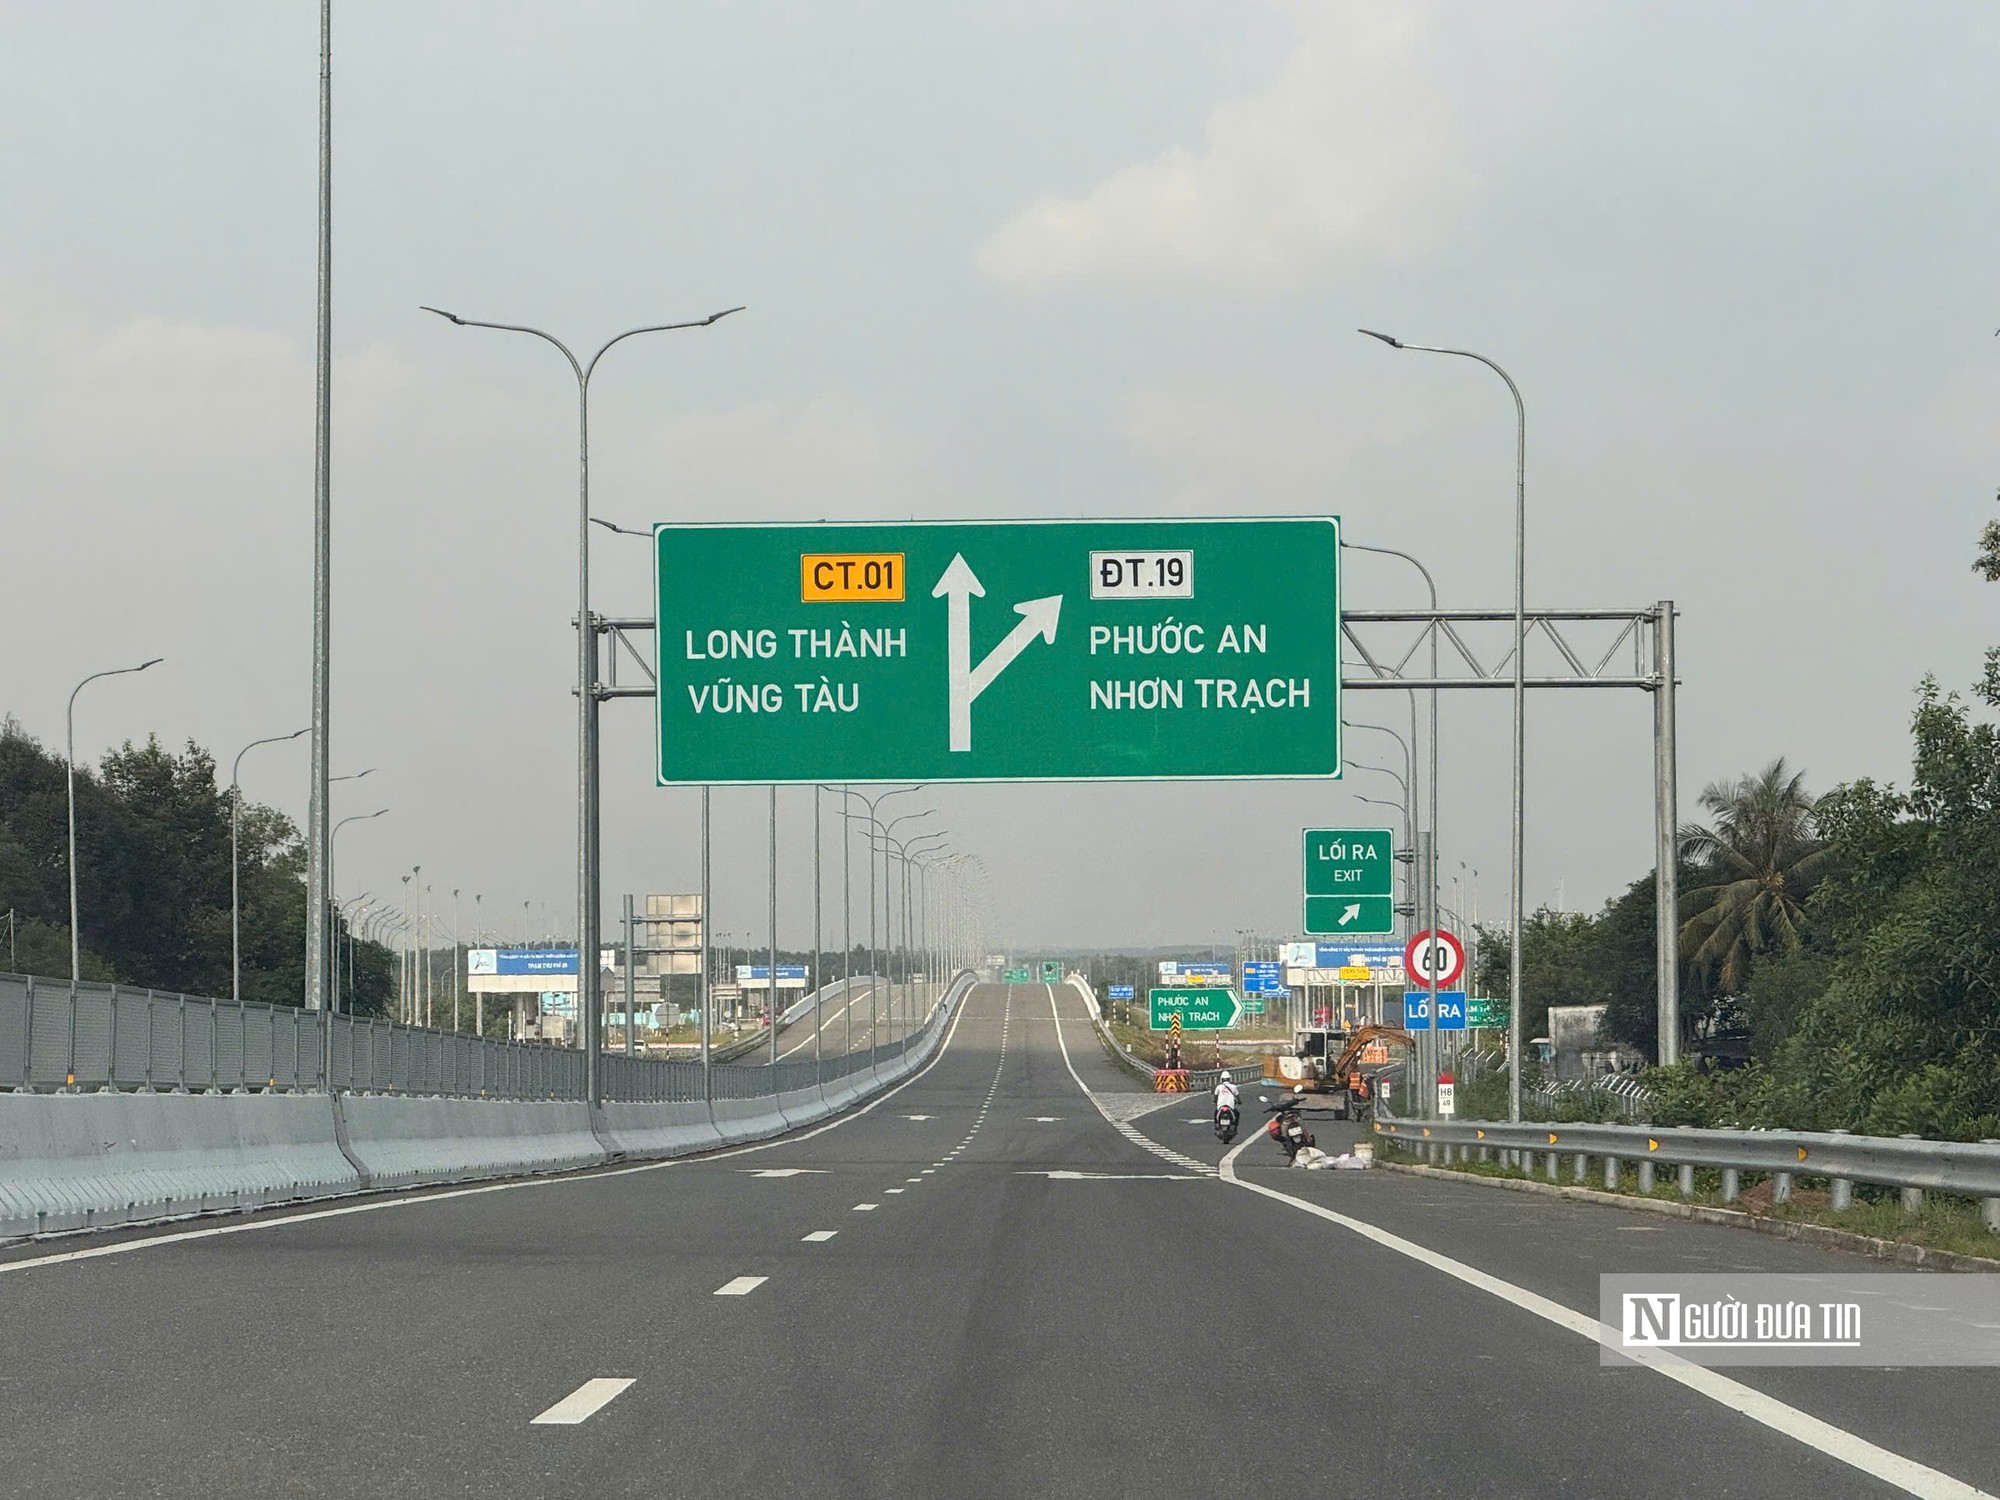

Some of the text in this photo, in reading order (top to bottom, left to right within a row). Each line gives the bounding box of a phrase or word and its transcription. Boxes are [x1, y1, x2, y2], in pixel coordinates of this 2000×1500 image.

[814, 560, 893, 590] CT.01
[1100, 557, 1184, 588] ĐT.19
[686, 620, 906, 660] LONG THÀNH
[1090, 616, 1267, 655] PHƯỚC AN
[687, 675, 859, 714] VŨNG TÀU
[1090, 676, 1310, 714] NHƠN TRẠCH
[1319, 838, 1378, 860] LỐI RA
[1334, 869, 1363, 882] EXIT
[1422, 946, 1447, 972] 60
[1157, 994, 1209, 1006] PHƯỚC AN
[1408, 997, 1430, 1018] LỐ
[1438, 1003, 1462, 1018] RA
[1158, 1011, 1220, 1024] NH TRẠCH
[1440, 1087, 1453, 1096] H8
